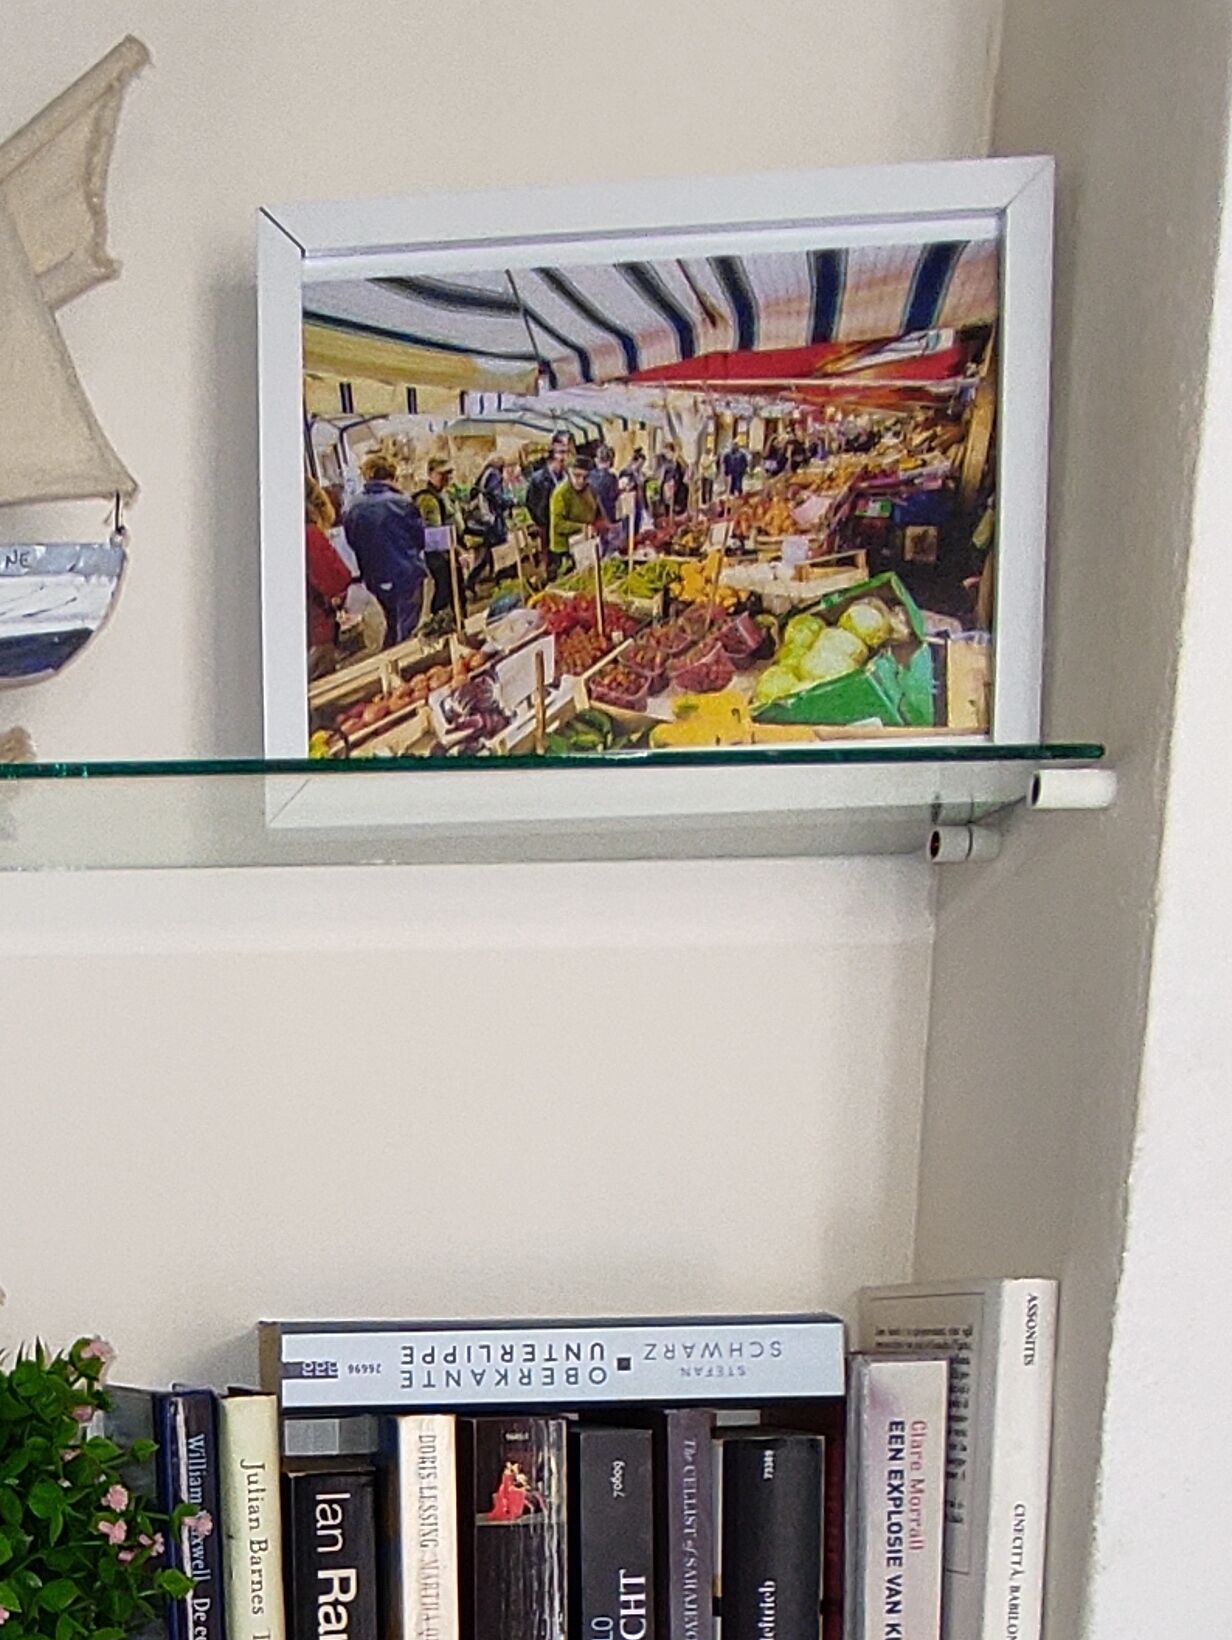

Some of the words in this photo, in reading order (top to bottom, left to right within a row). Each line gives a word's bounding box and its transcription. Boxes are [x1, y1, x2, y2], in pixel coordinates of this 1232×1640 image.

[399, 1342, 605, 1364] UNTERLIPPE
[642, 1340, 782, 1361] SCHWARZ
[1023, 1293, 1037, 1365] ASSONITIS
[347, 1363, 382, 1374] 26696
[398, 1366, 607, 1388] OBERKANTE
[680, 1366, 747, 1376] STEFAN
[417, 1434, 439, 1481] DORIS
[682, 1439, 697, 1461] The
[887, 1421, 906, 1461] EEN
[908, 1420, 927, 1471] Clare
[186, 1433, 209, 1504] William
[611, 1461, 623, 1497] 70609
[239, 1459, 268, 1530] Julian
[419, 1485, 440, 1549] LESSING
[682, 1465, 697, 1538] CELLIST
[885, 1469, 906, 1567] EXPLOSIE
[908, 1478, 925, 1550] Morrall
[190, 1510, 212, 1582] xwell
[316, 1492, 350, 1552] Ian
[1008, 1504, 1026, 1581] CINECITTÀ,
[682, 1541, 697, 1555] of
[249, 1539, 269, 1615] Barnes
[419, 1557, 441, 1621] MARTHA
[883, 1574, 904, 1615] VAN
[192, 1598, 213, 1625] De
